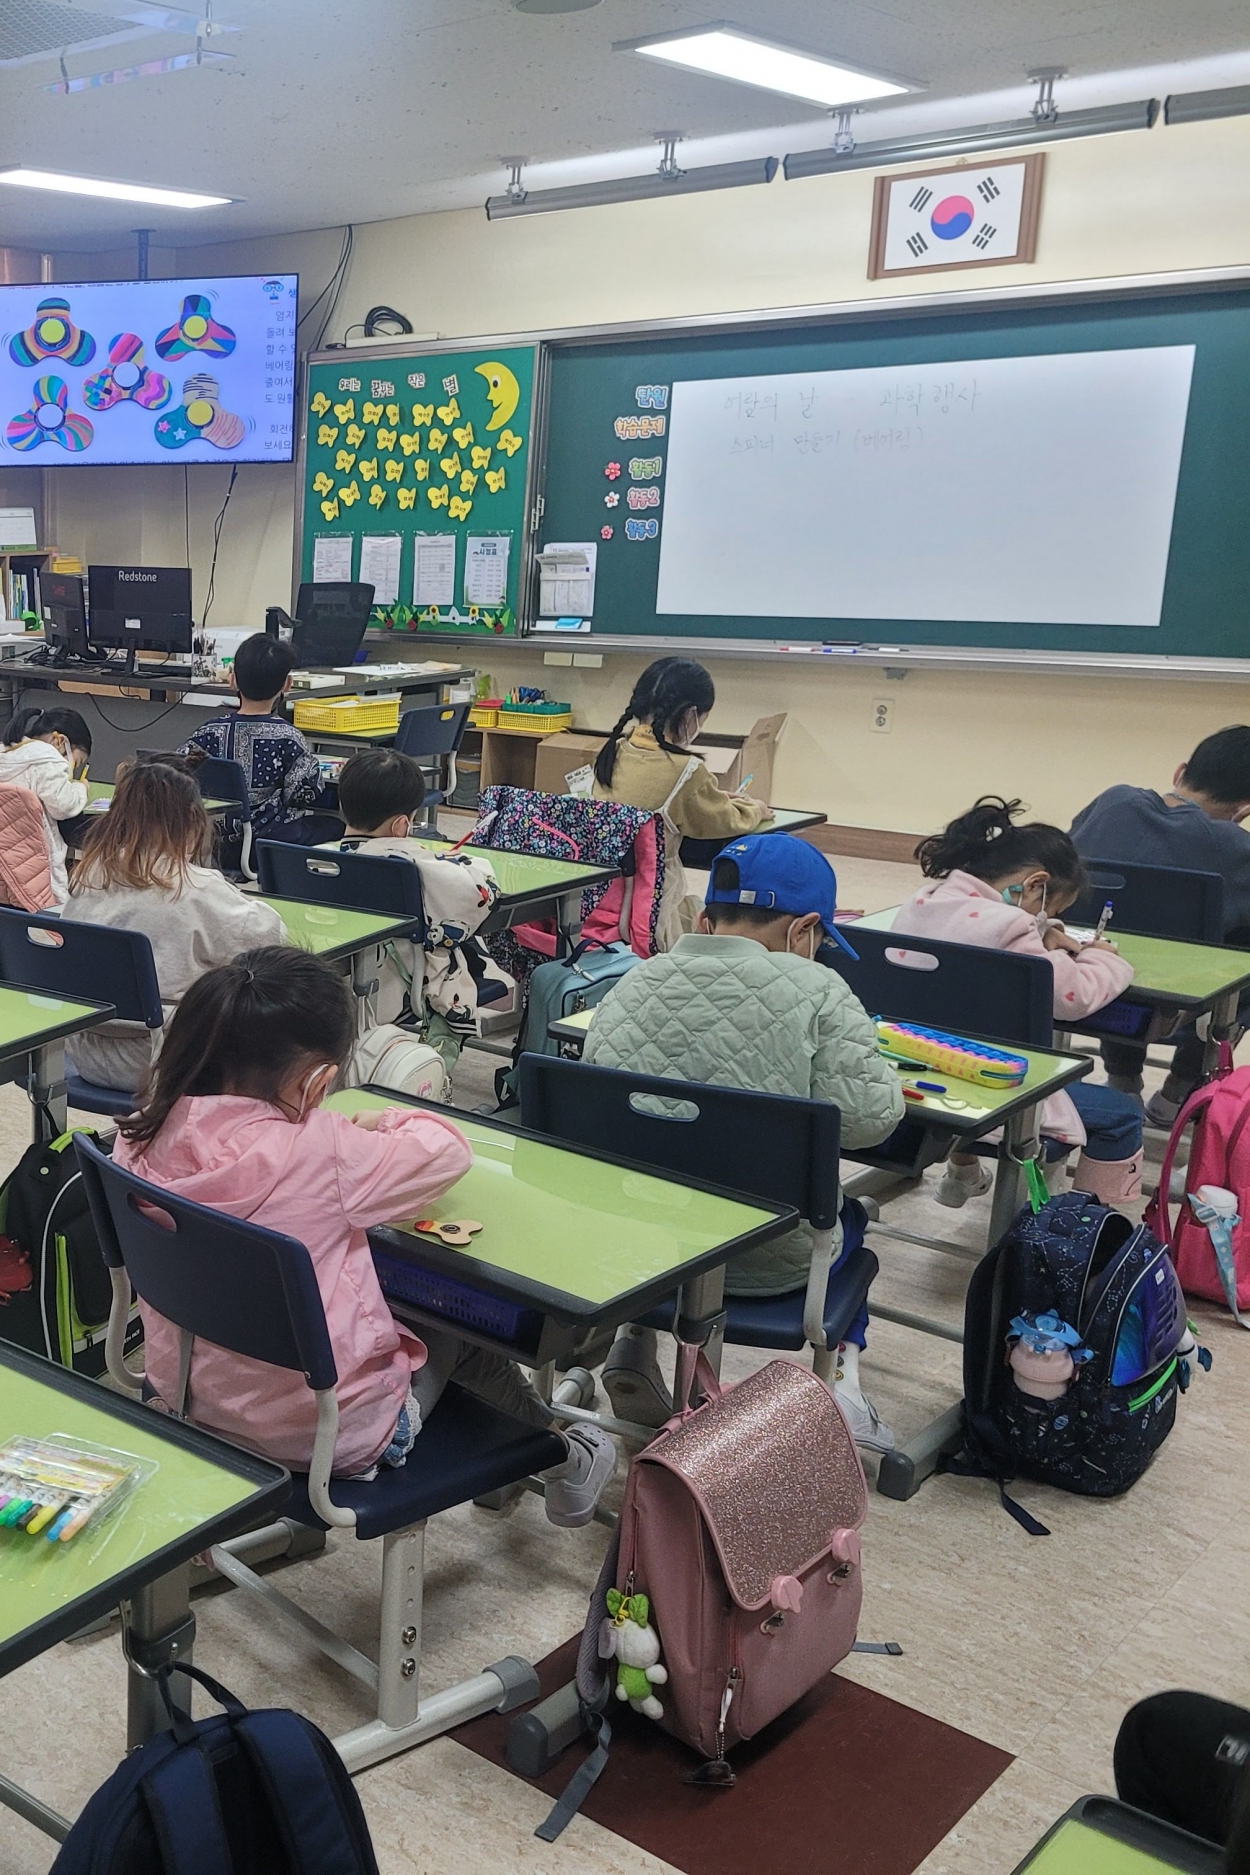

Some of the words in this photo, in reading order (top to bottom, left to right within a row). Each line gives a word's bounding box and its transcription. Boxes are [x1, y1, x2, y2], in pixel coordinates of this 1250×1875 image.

[275, 310, 294, 322] 엄지
[266, 327, 285, 339] 돌려
[278, 344, 287, 355] 수
[265, 360, 293, 372] 베어링
[264, 377, 293, 389] 줄여서
[339, 378, 361, 391] 우리는
[371, 380, 394, 397] 꿈꾸는
[408, 374, 425, 388] 작은
[443, 375, 457, 395] 별
[637, 386, 667, 408] 단원
[616, 417, 664, 438] 학습문제
[264, 440, 292, 451] 보세요
[118, 570, 158, 582] Redstone
